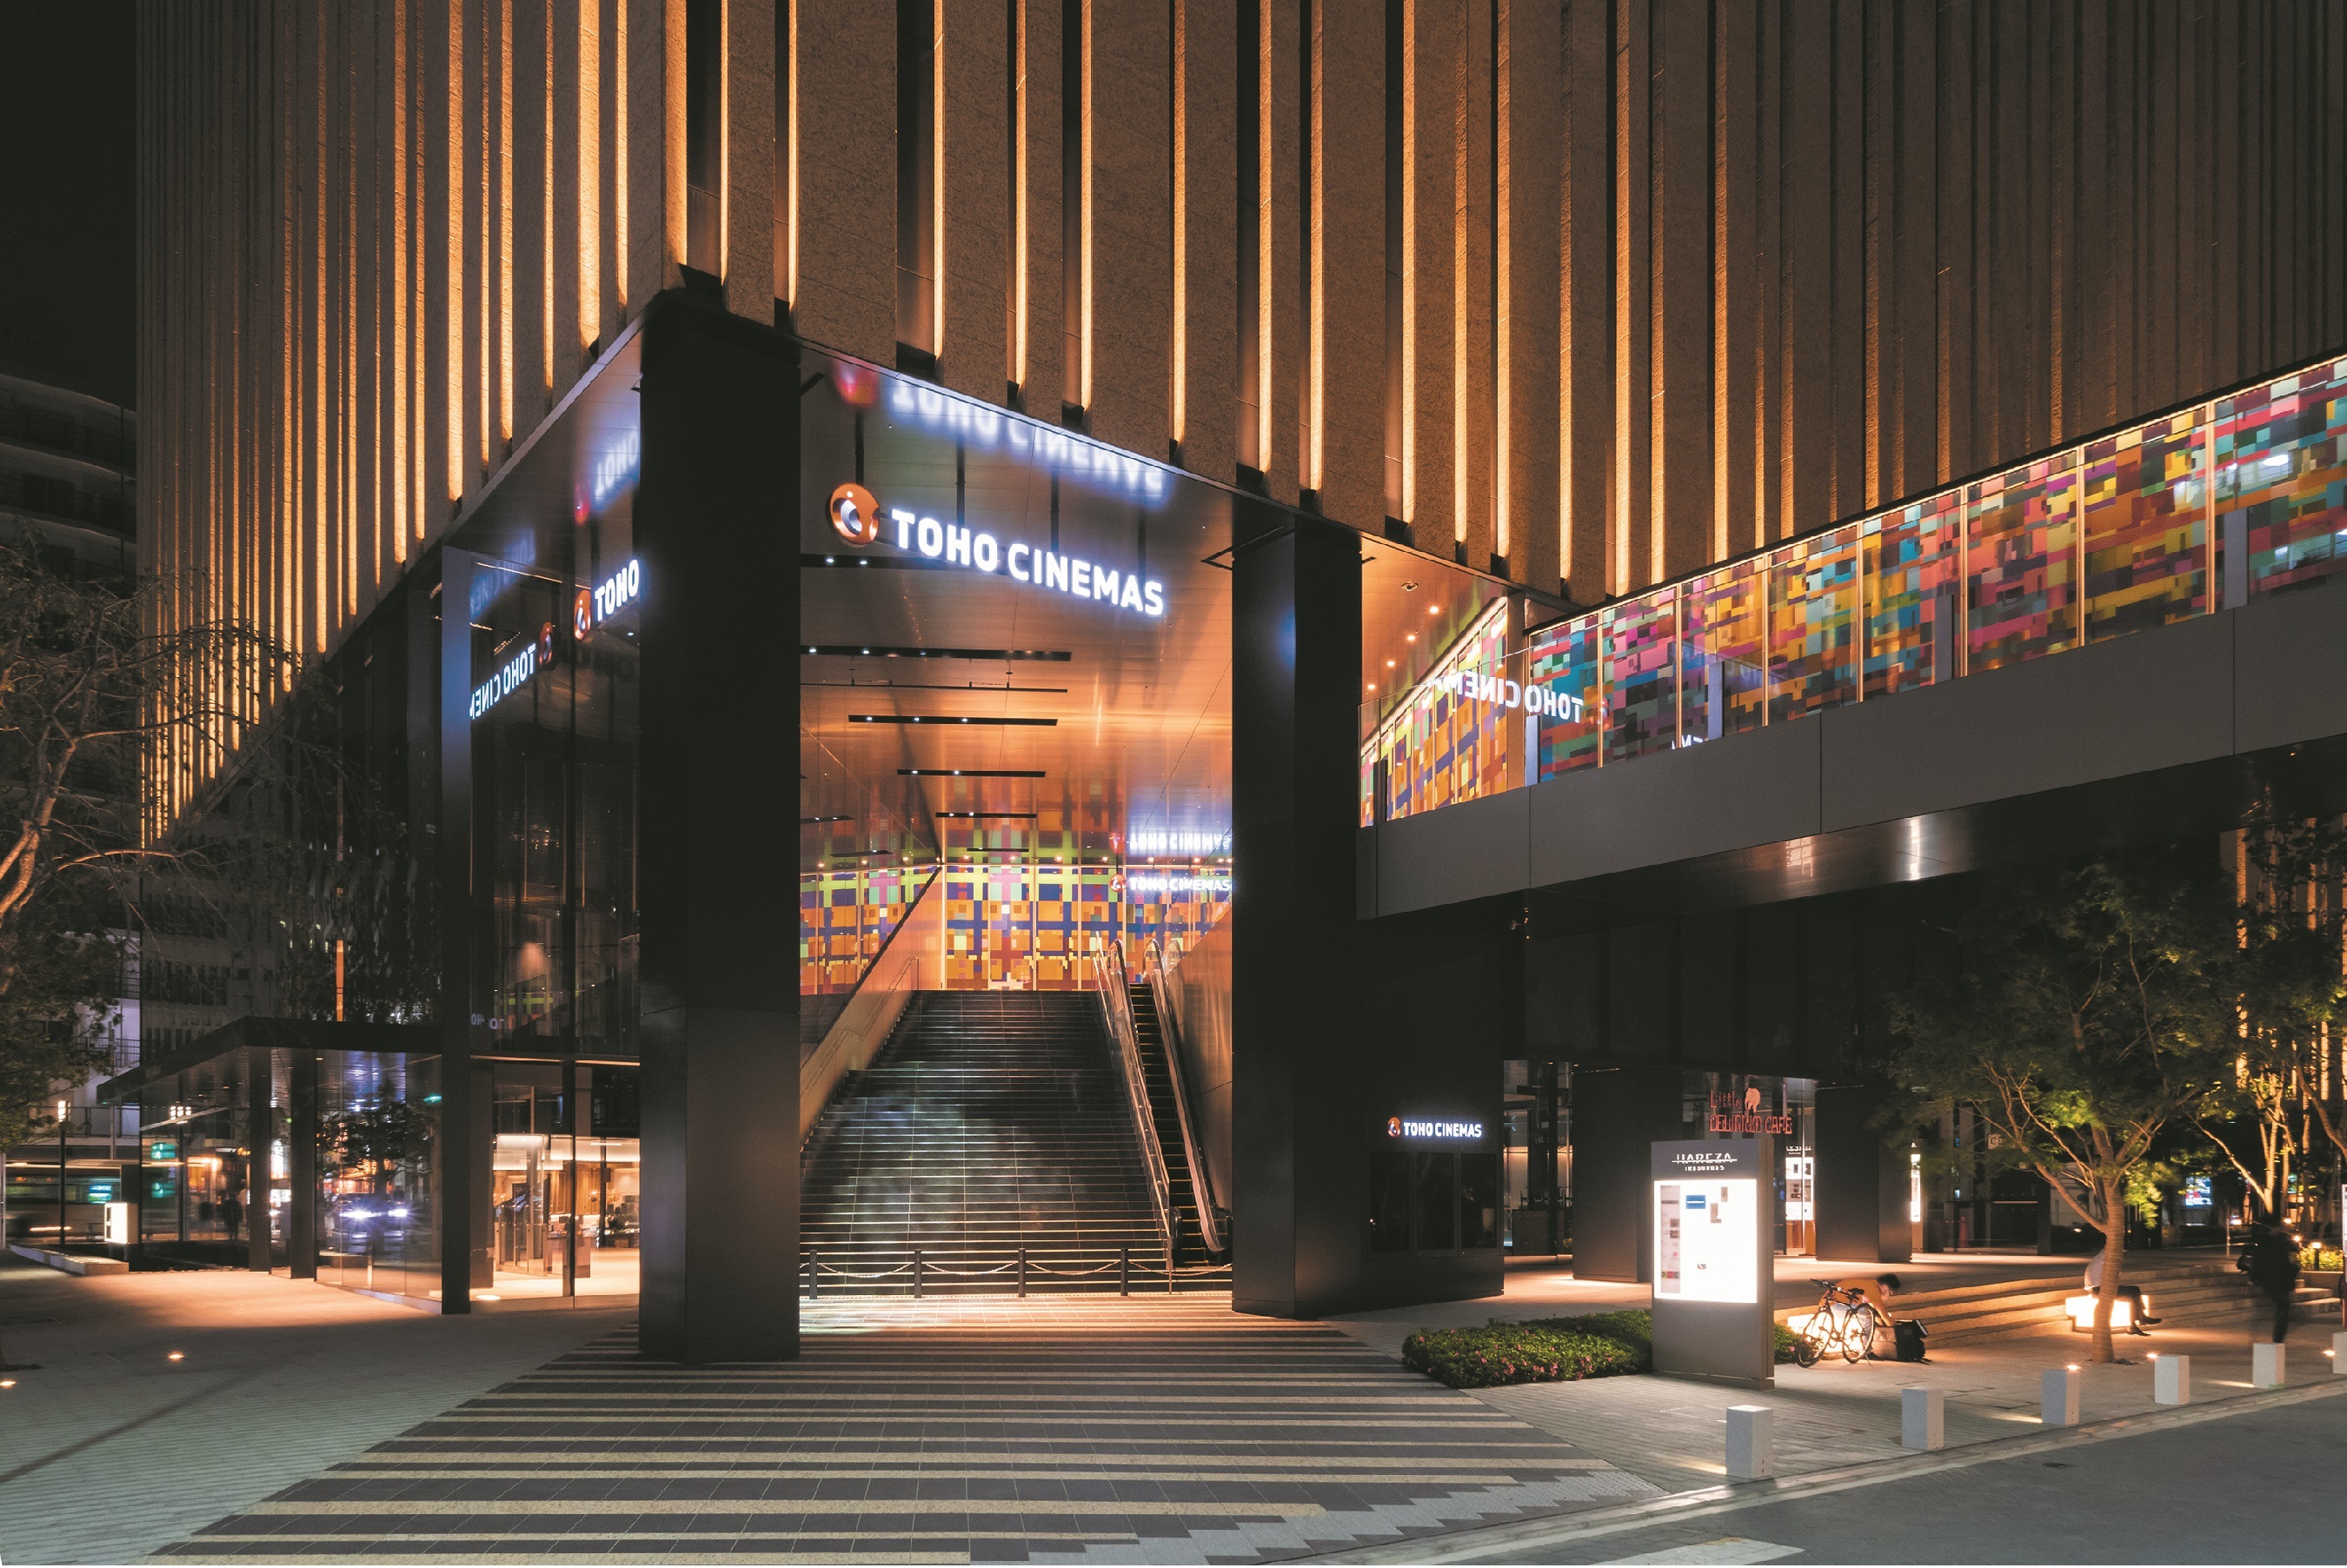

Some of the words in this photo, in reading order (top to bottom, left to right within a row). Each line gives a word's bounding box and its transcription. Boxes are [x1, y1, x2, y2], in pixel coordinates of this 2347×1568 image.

[892, 508, 999, 573] TOHO
[1008, 543, 1164, 617] CINEMAS
[595, 559, 639, 621] TOHO
[1129, 877, 1167, 891] TOHO
[1168, 877, 1231, 892] CINEMAS
[1710, 1090, 1742, 1109] Little
[1403, 1122, 1434, 1137] TOHO
[1434, 1122, 1482, 1138] CINEMAS
